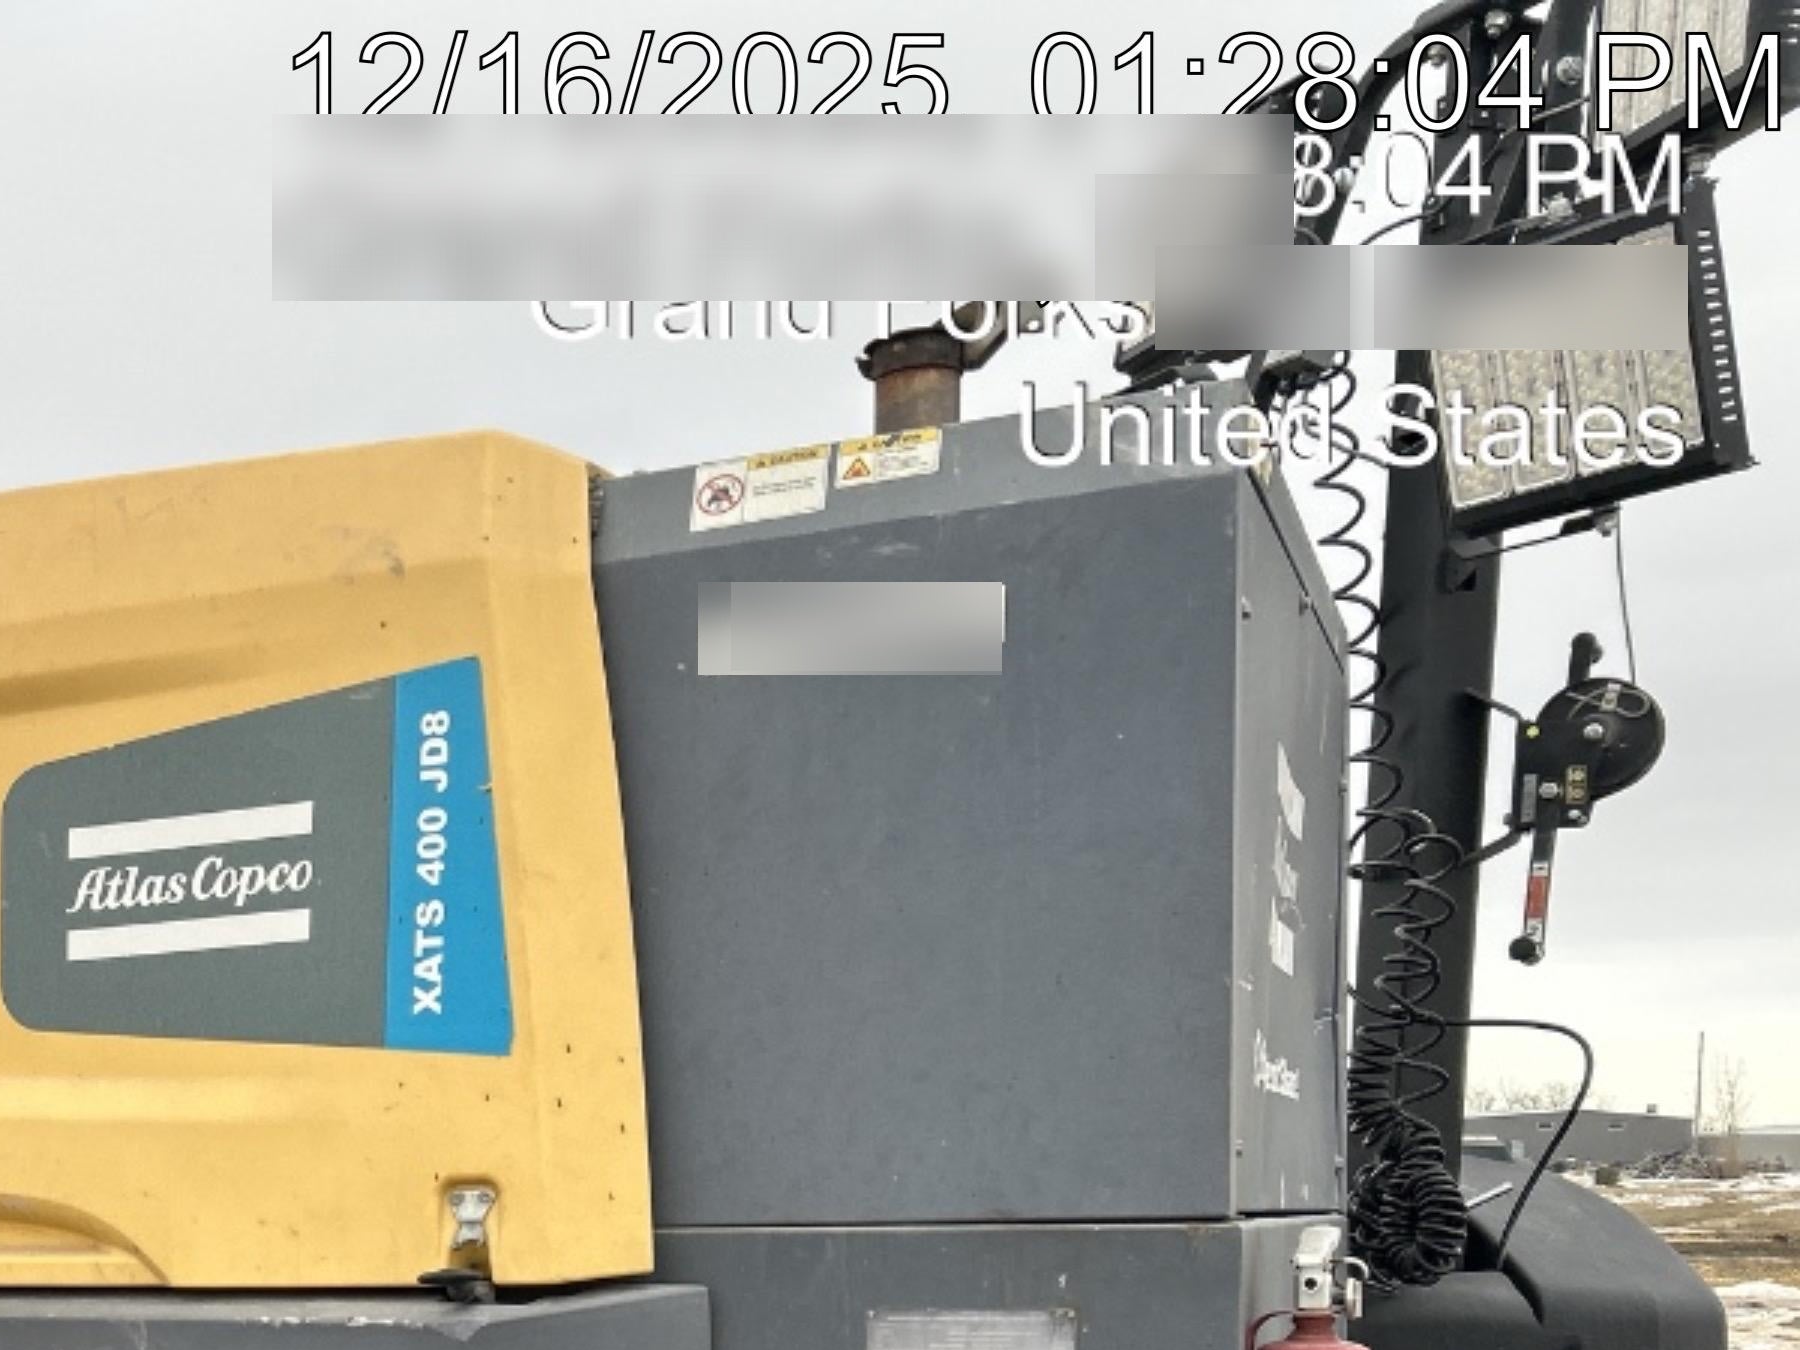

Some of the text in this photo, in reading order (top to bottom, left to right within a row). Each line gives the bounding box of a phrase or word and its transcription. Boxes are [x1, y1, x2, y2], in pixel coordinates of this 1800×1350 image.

[66, 855, 314, 913] Atlas Copco
[412, 709, 452, 1015] XATS 400 JD8
